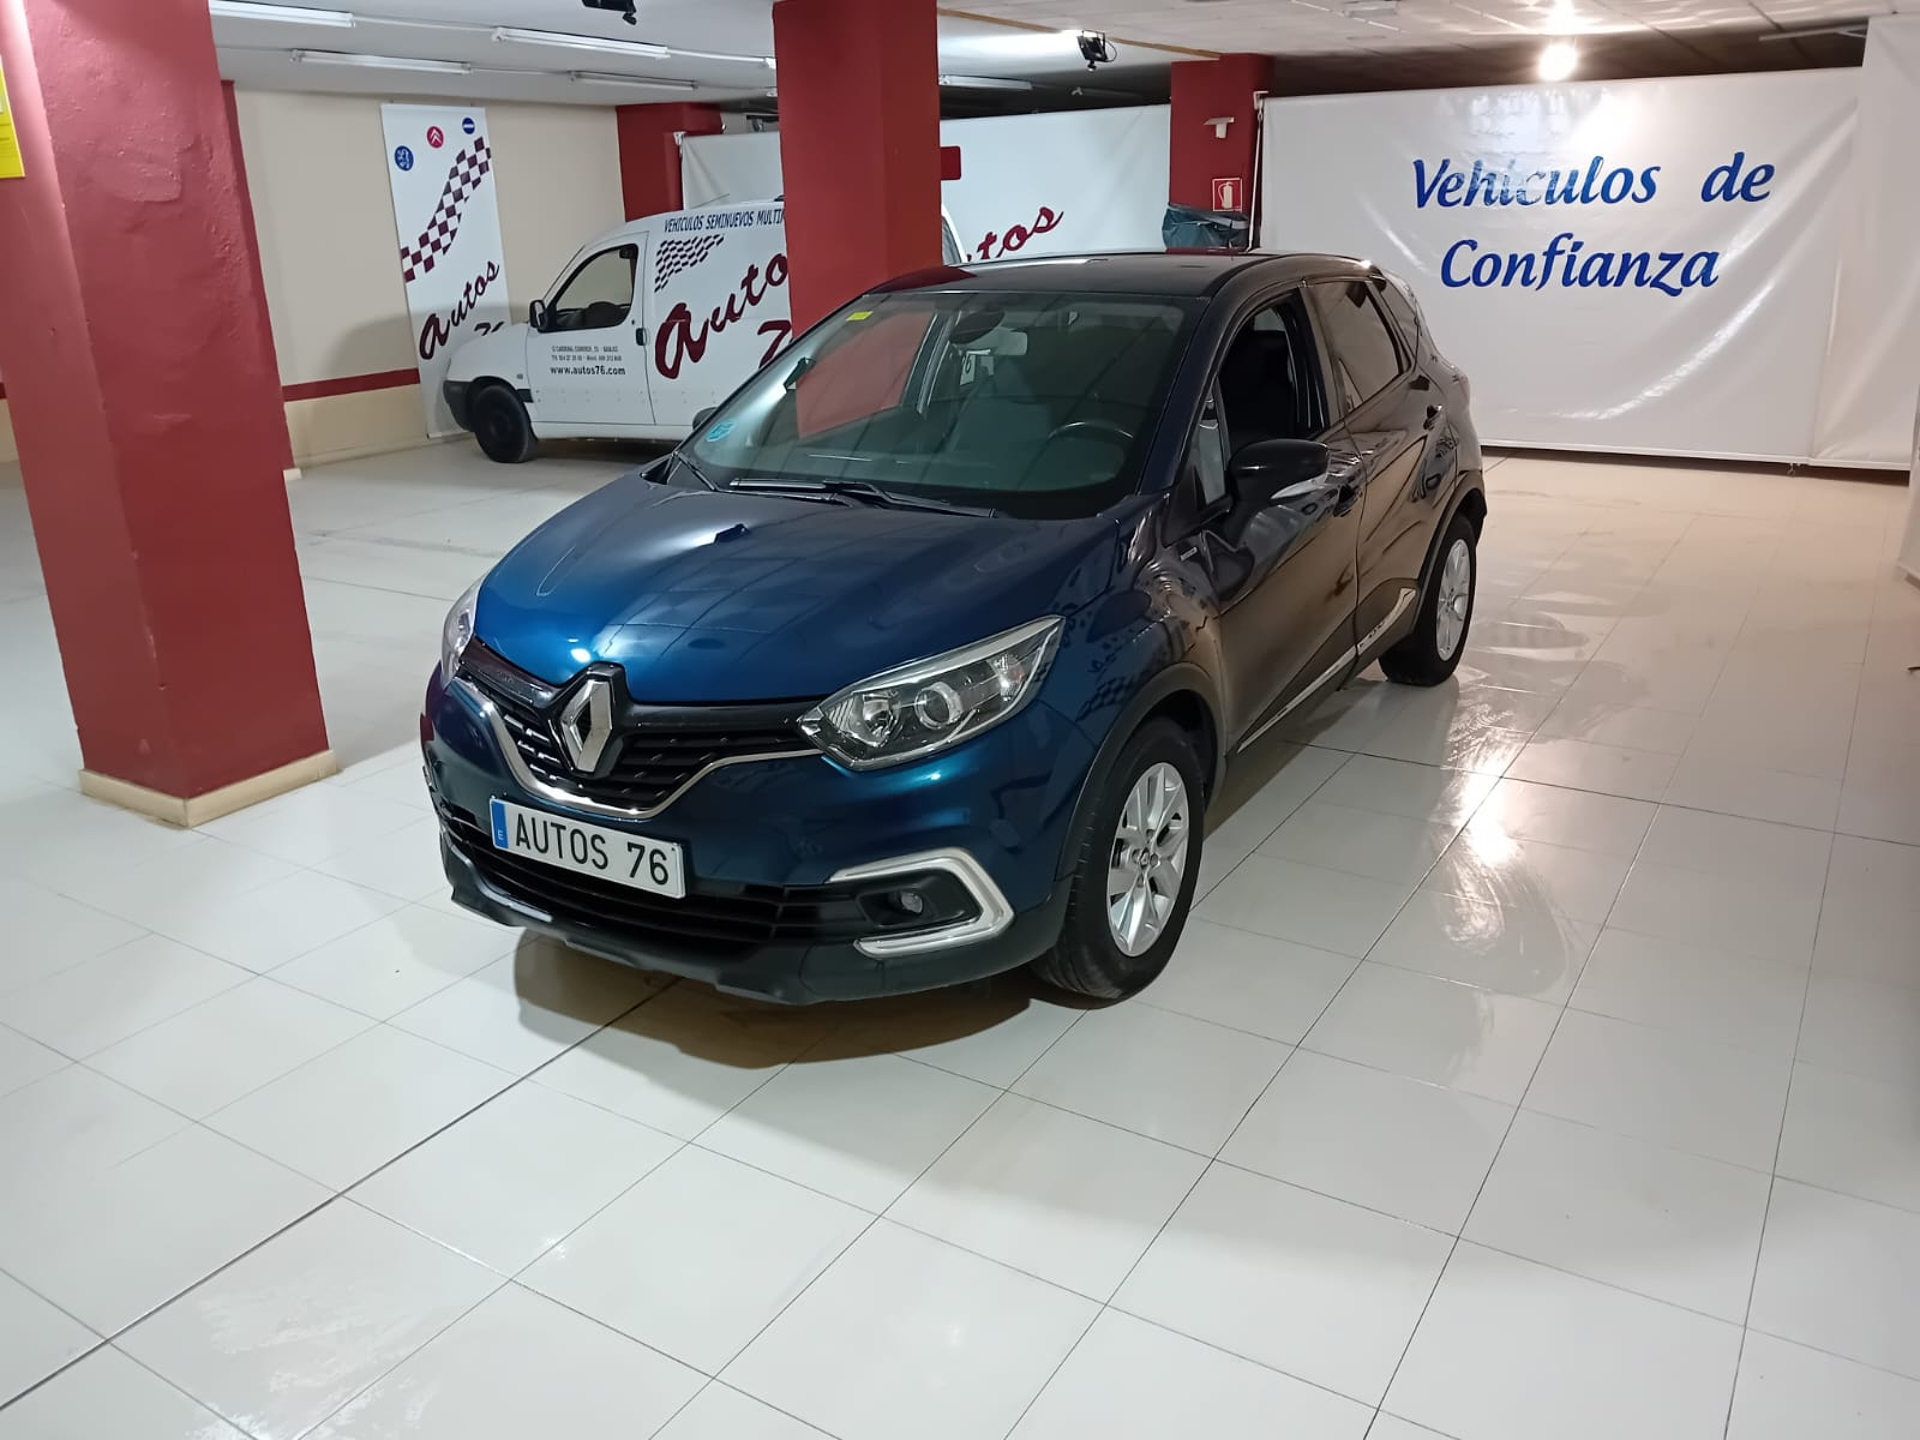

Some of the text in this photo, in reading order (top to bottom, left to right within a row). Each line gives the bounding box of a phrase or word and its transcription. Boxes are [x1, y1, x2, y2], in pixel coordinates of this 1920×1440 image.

[1701, 151, 1775, 202] de
[705, 210, 754, 230] SEMINUEVOS
[757, 208, 785, 226] MULTI
[1440, 232, 1720, 297] Confianza
[654, 253, 788, 379] Auto
[757, 319, 792, 369] 7
[550, 365, 626, 375] www.autos76.com
[515, 813, 669, 886] AUTOS 76
